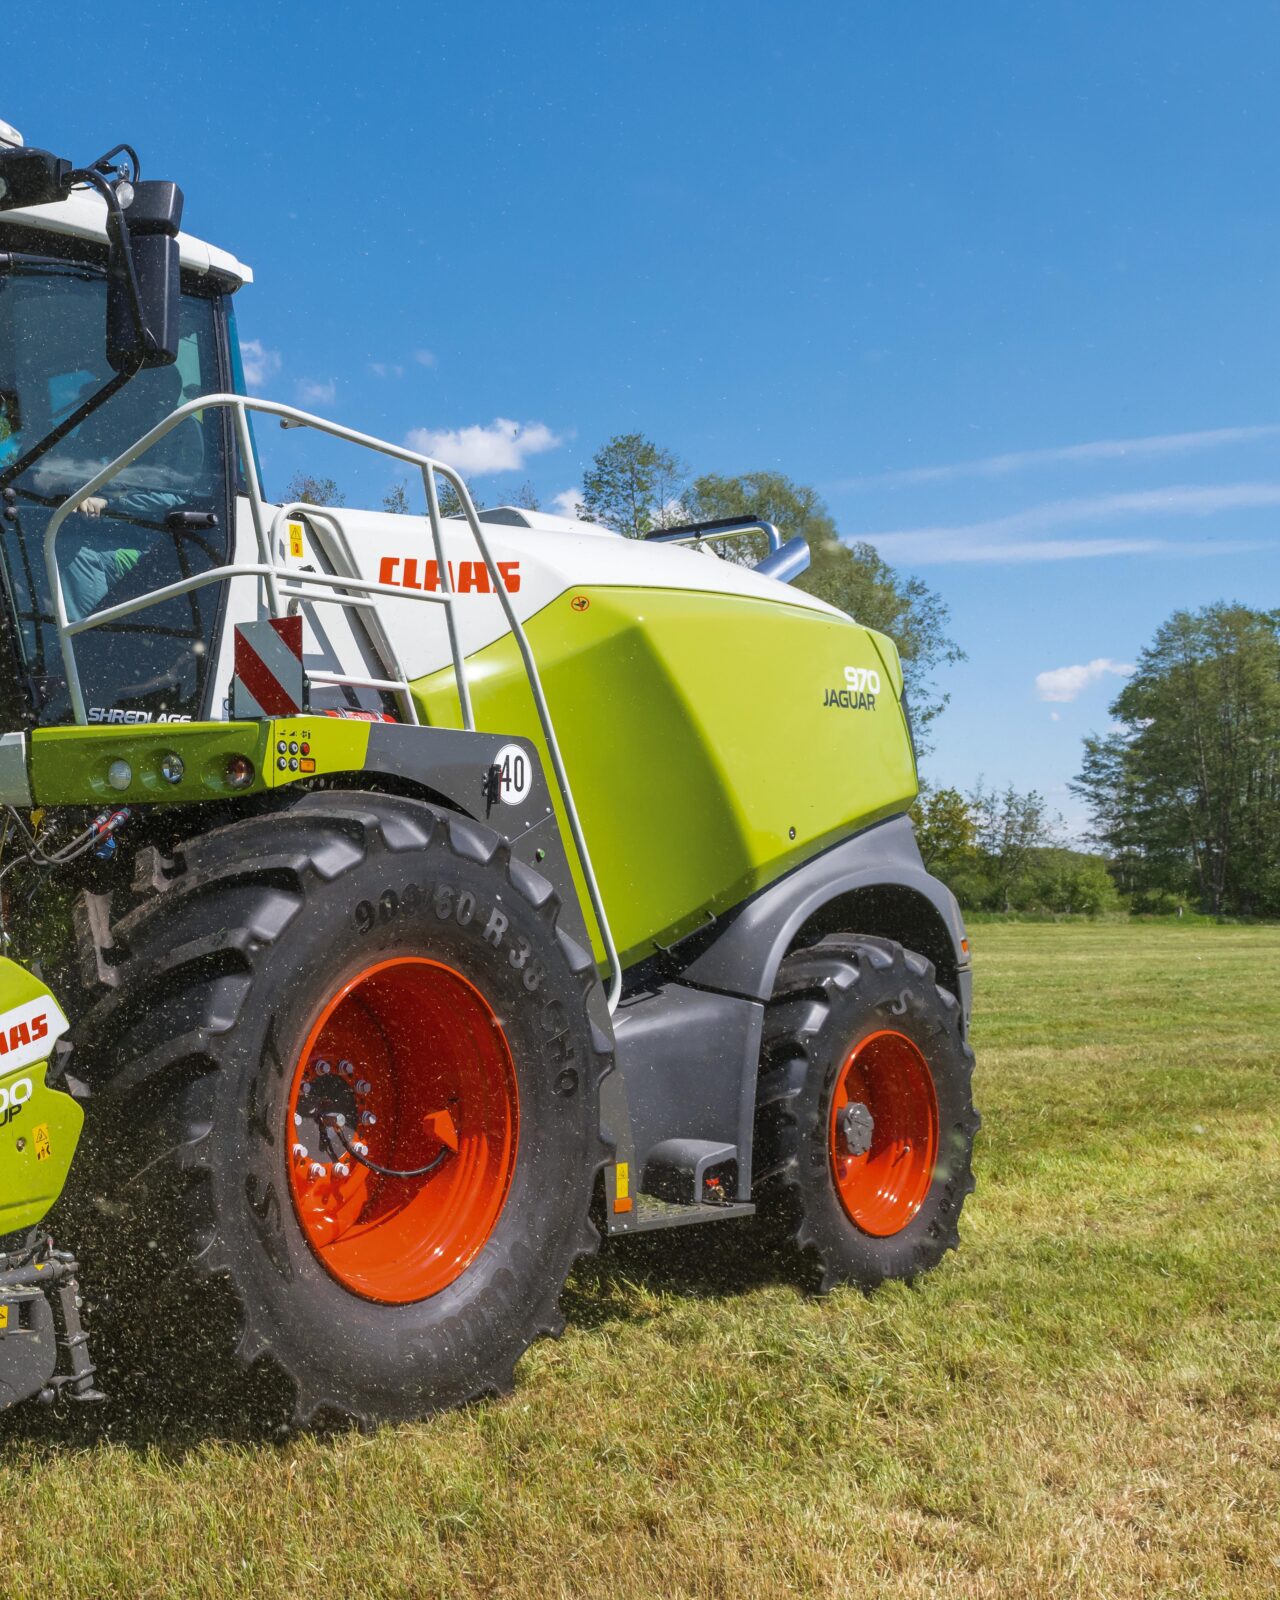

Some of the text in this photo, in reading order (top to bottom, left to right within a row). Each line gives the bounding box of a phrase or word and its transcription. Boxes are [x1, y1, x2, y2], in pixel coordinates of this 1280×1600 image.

[844, 665, 880, 694] 970
[823, 688, 876, 711] JAGUAR
[500, 754, 525, 793] 40
